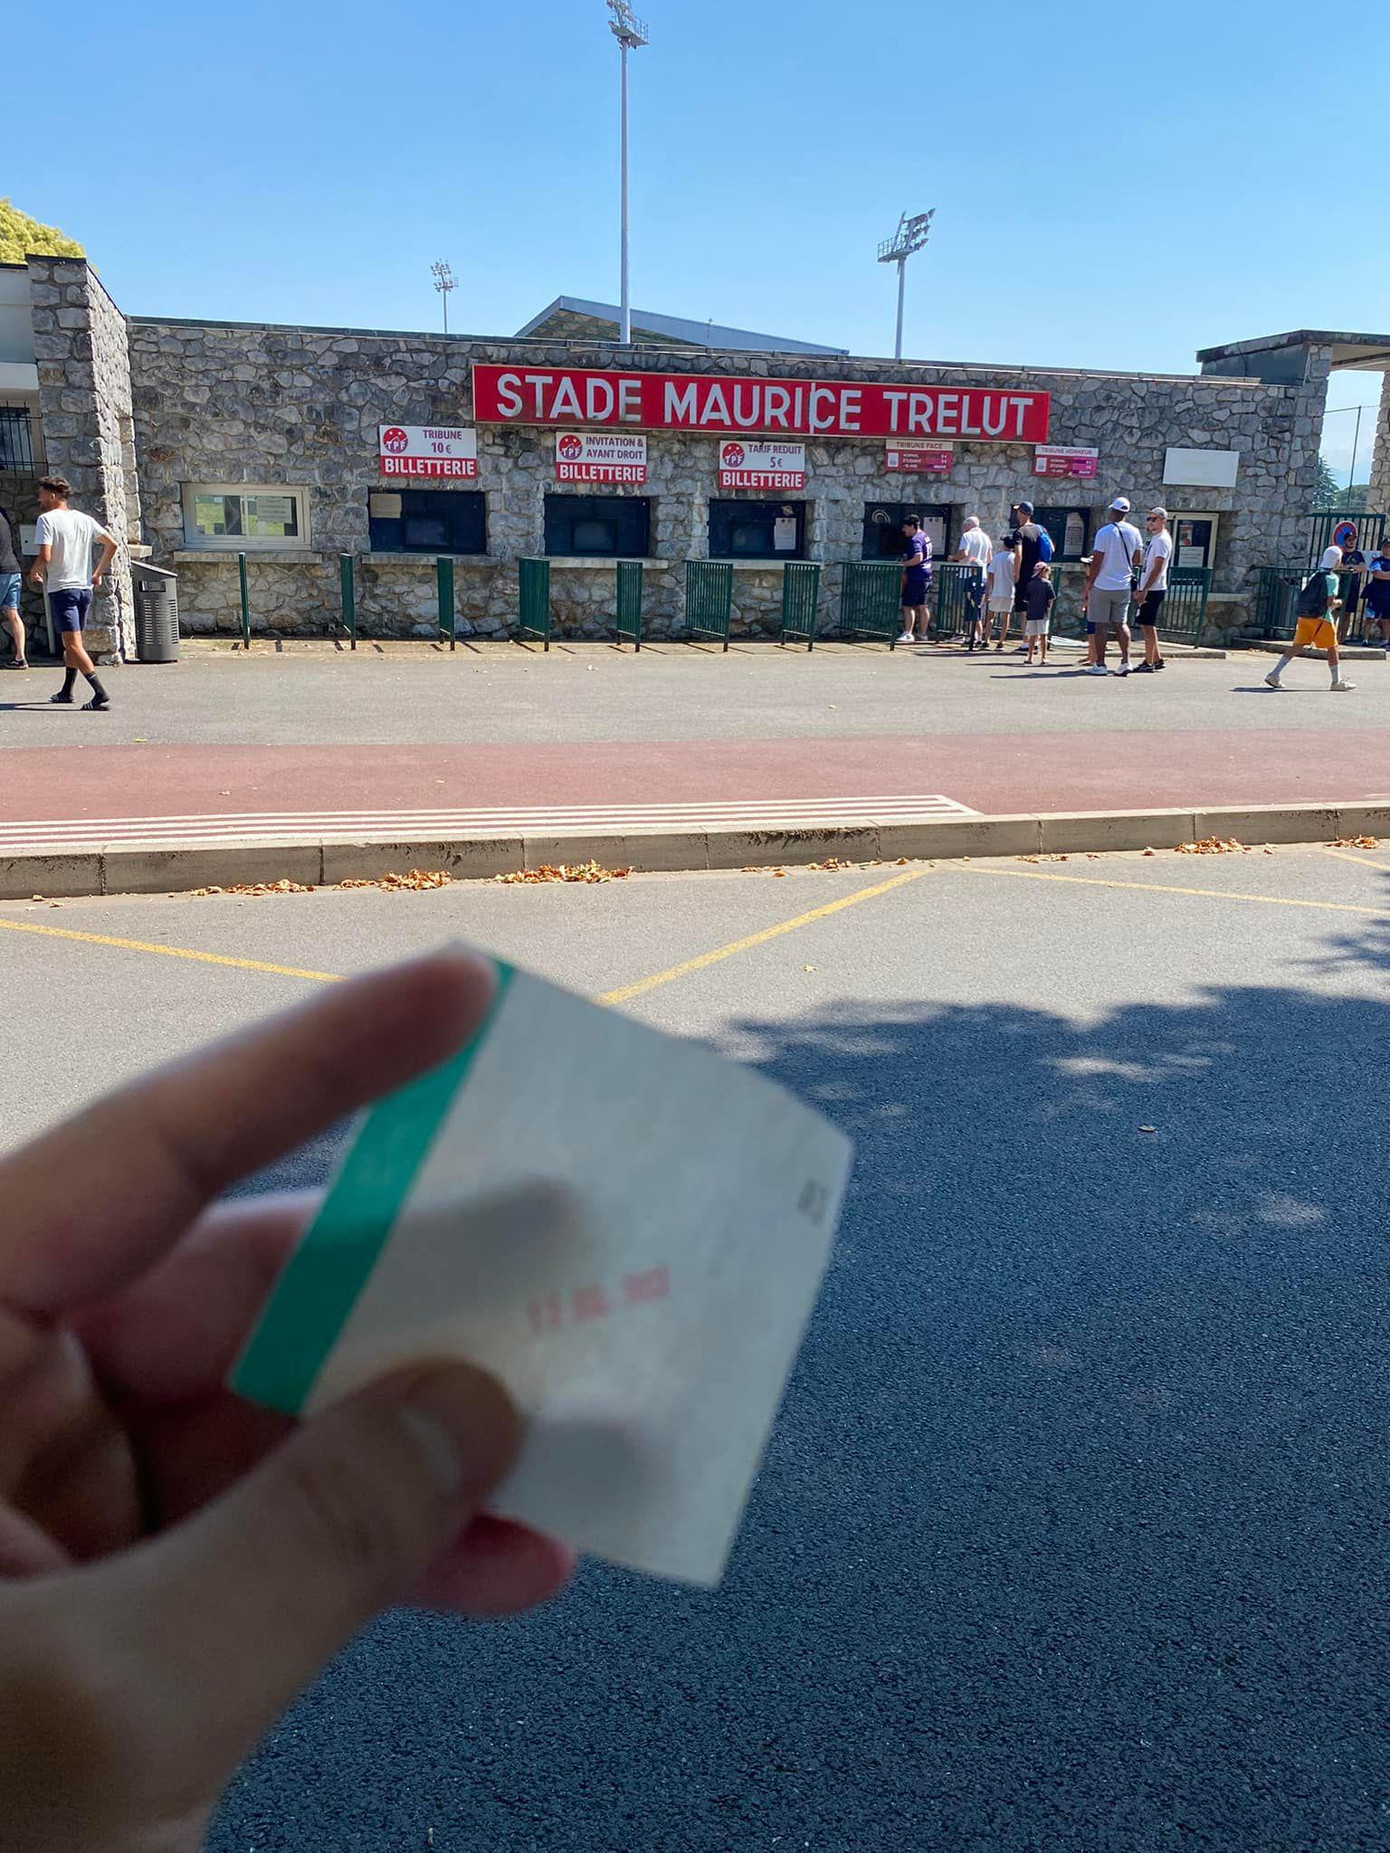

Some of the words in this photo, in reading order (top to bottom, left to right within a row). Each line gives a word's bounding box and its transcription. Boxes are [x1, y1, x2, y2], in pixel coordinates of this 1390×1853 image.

[496, 373, 642, 422] STADE
[664, 382, 862, 431] MAURICE
[883, 391, 1034, 437] TRELUT
[422, 430, 462, 440] TRIBUNE
[386, 441, 406, 450] TPF
[586, 436, 635, 447] INVITATION
[637, 439, 644, 447] &
[896, 441, 925, 449] TRIBUNE
[431, 442, 444, 453] 10
[446, 444, 452, 454] €
[561, 448, 580, 457] TPF
[748, 444, 772, 453] TARIF
[773, 445, 802, 455] REDUIT
[586, 449, 615, 458] AYANT
[617, 450, 644, 460] DROIT
[725, 455, 743, 464] TPF
[385, 458, 475, 475] BILLETTERIE
[770, 457, 776, 468] 5
[778, 458, 783, 467] €
[559, 464, 644, 481] BILLETTERIE
[722, 471, 802, 488] BILLETTERIE
